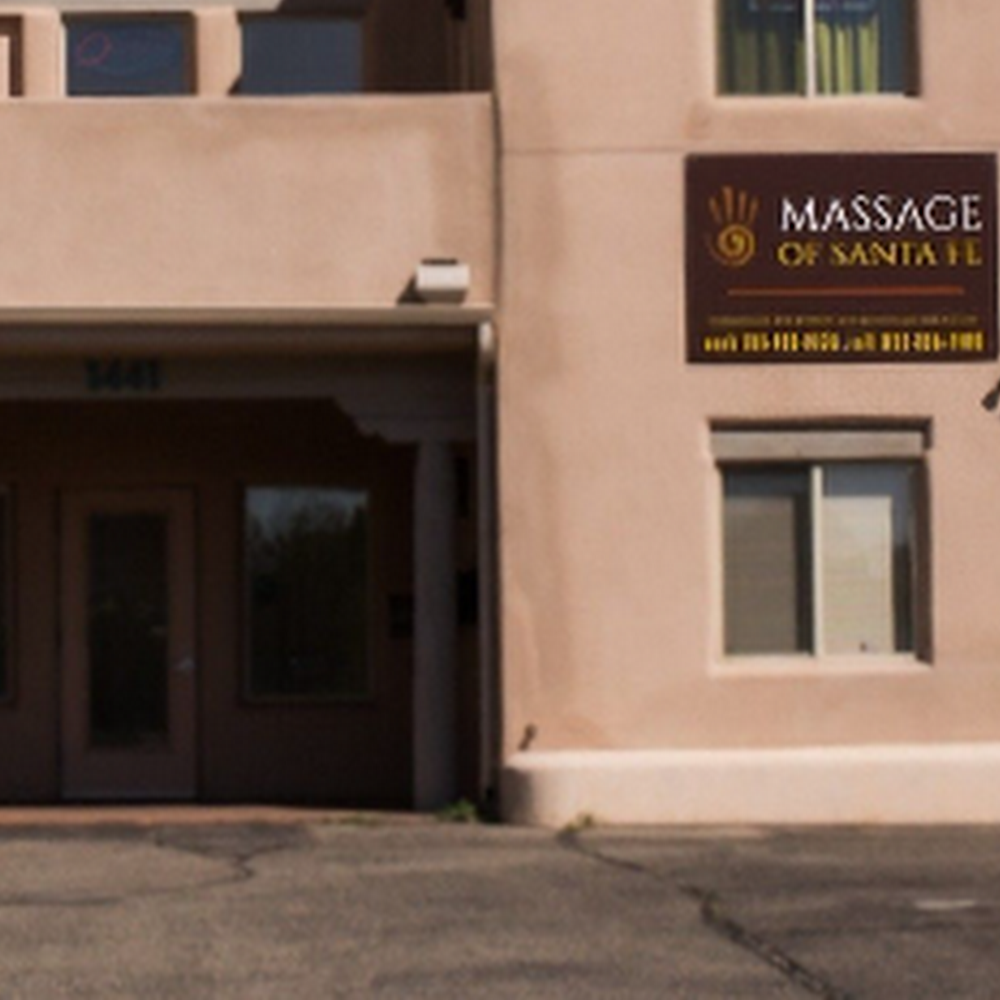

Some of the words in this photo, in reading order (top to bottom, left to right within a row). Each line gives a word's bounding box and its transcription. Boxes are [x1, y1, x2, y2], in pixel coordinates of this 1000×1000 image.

[779, 193, 983, 232] MASSAGE
[777, 241, 818, 266] OF
[829, 241, 938, 266] SANTA
